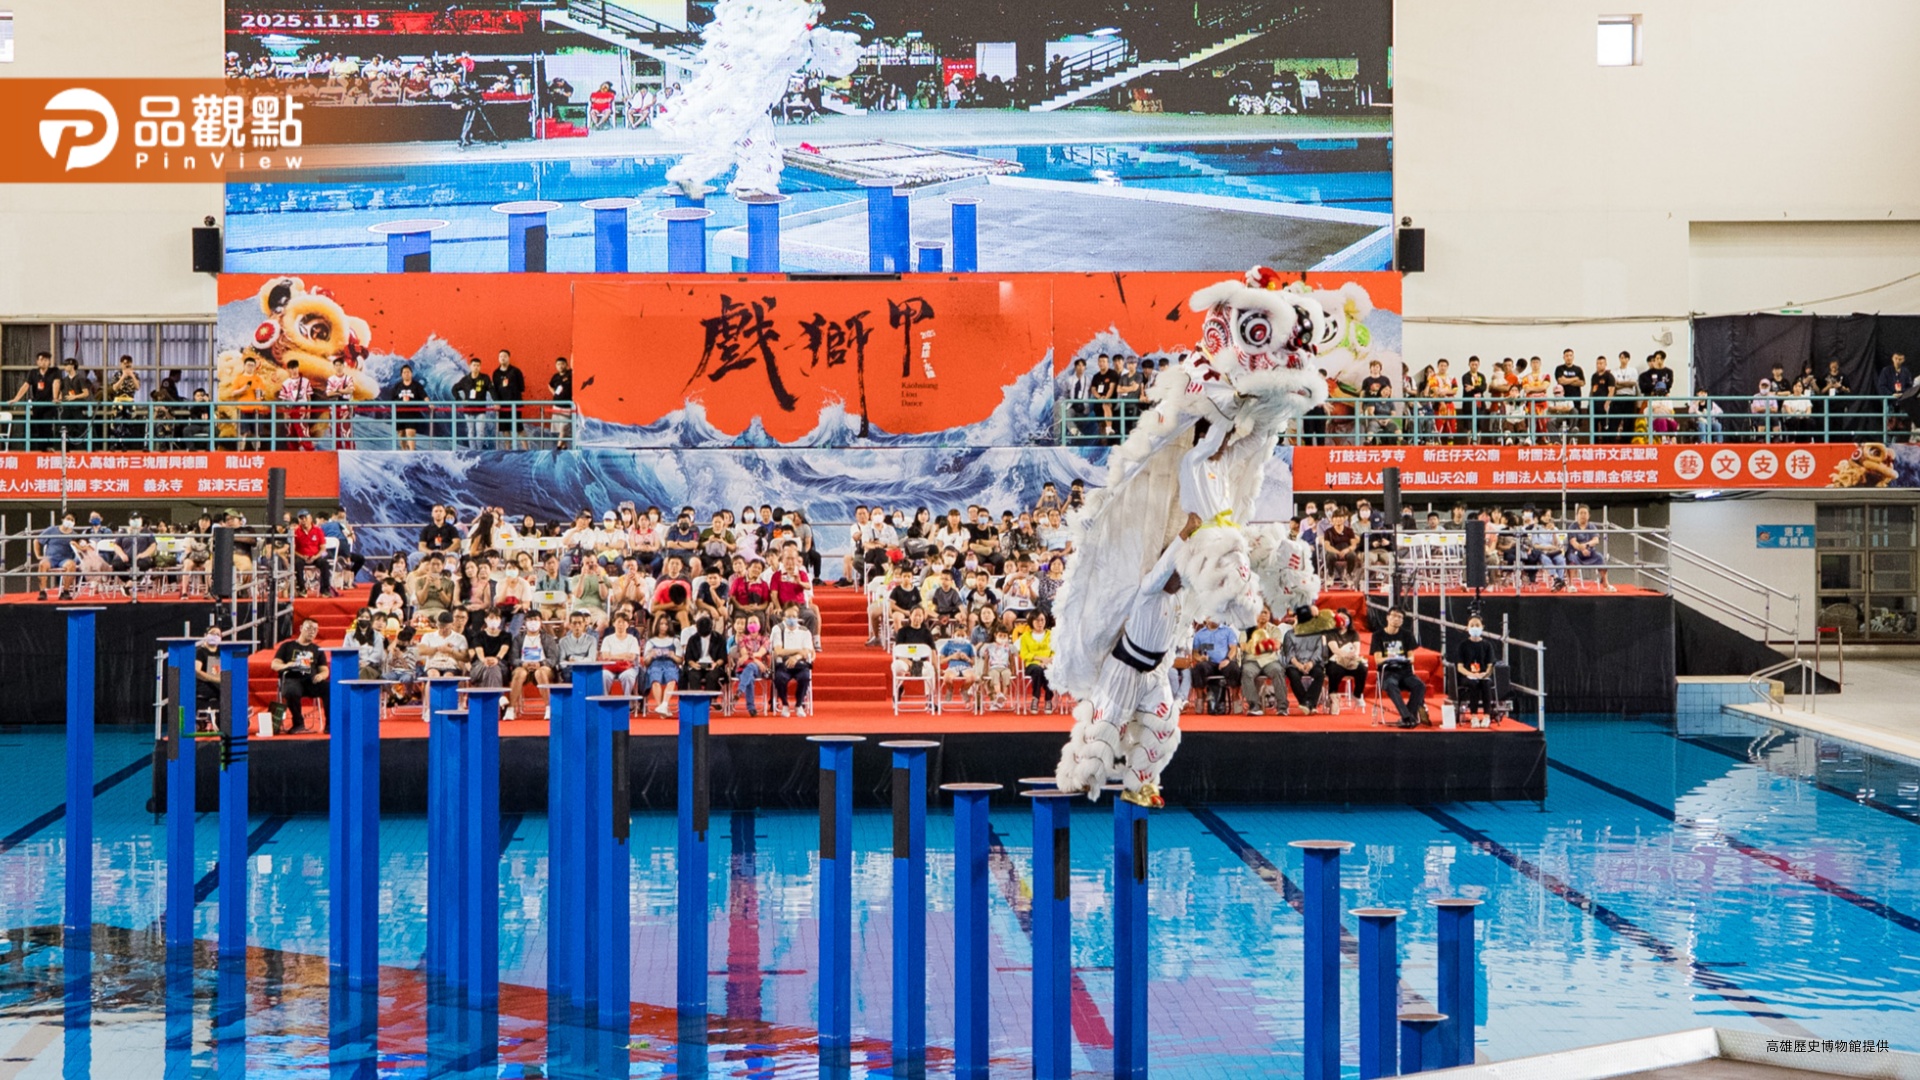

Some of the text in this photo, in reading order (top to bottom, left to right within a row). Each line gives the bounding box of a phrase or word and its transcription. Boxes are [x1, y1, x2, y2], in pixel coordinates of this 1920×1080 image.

[240, 14, 381, 28] 2025.11.15
[225, 456, 265, 469] 龍山寺
[1423, 449, 1500, 462] 新庄仔天公廟
[1680, 455, 1811, 474] 藝文支持
[89, 479, 129, 493] 李文洲
[143, 479, 183, 492] 義永寺
[198, 479, 264, 492] 旗津天后宮
